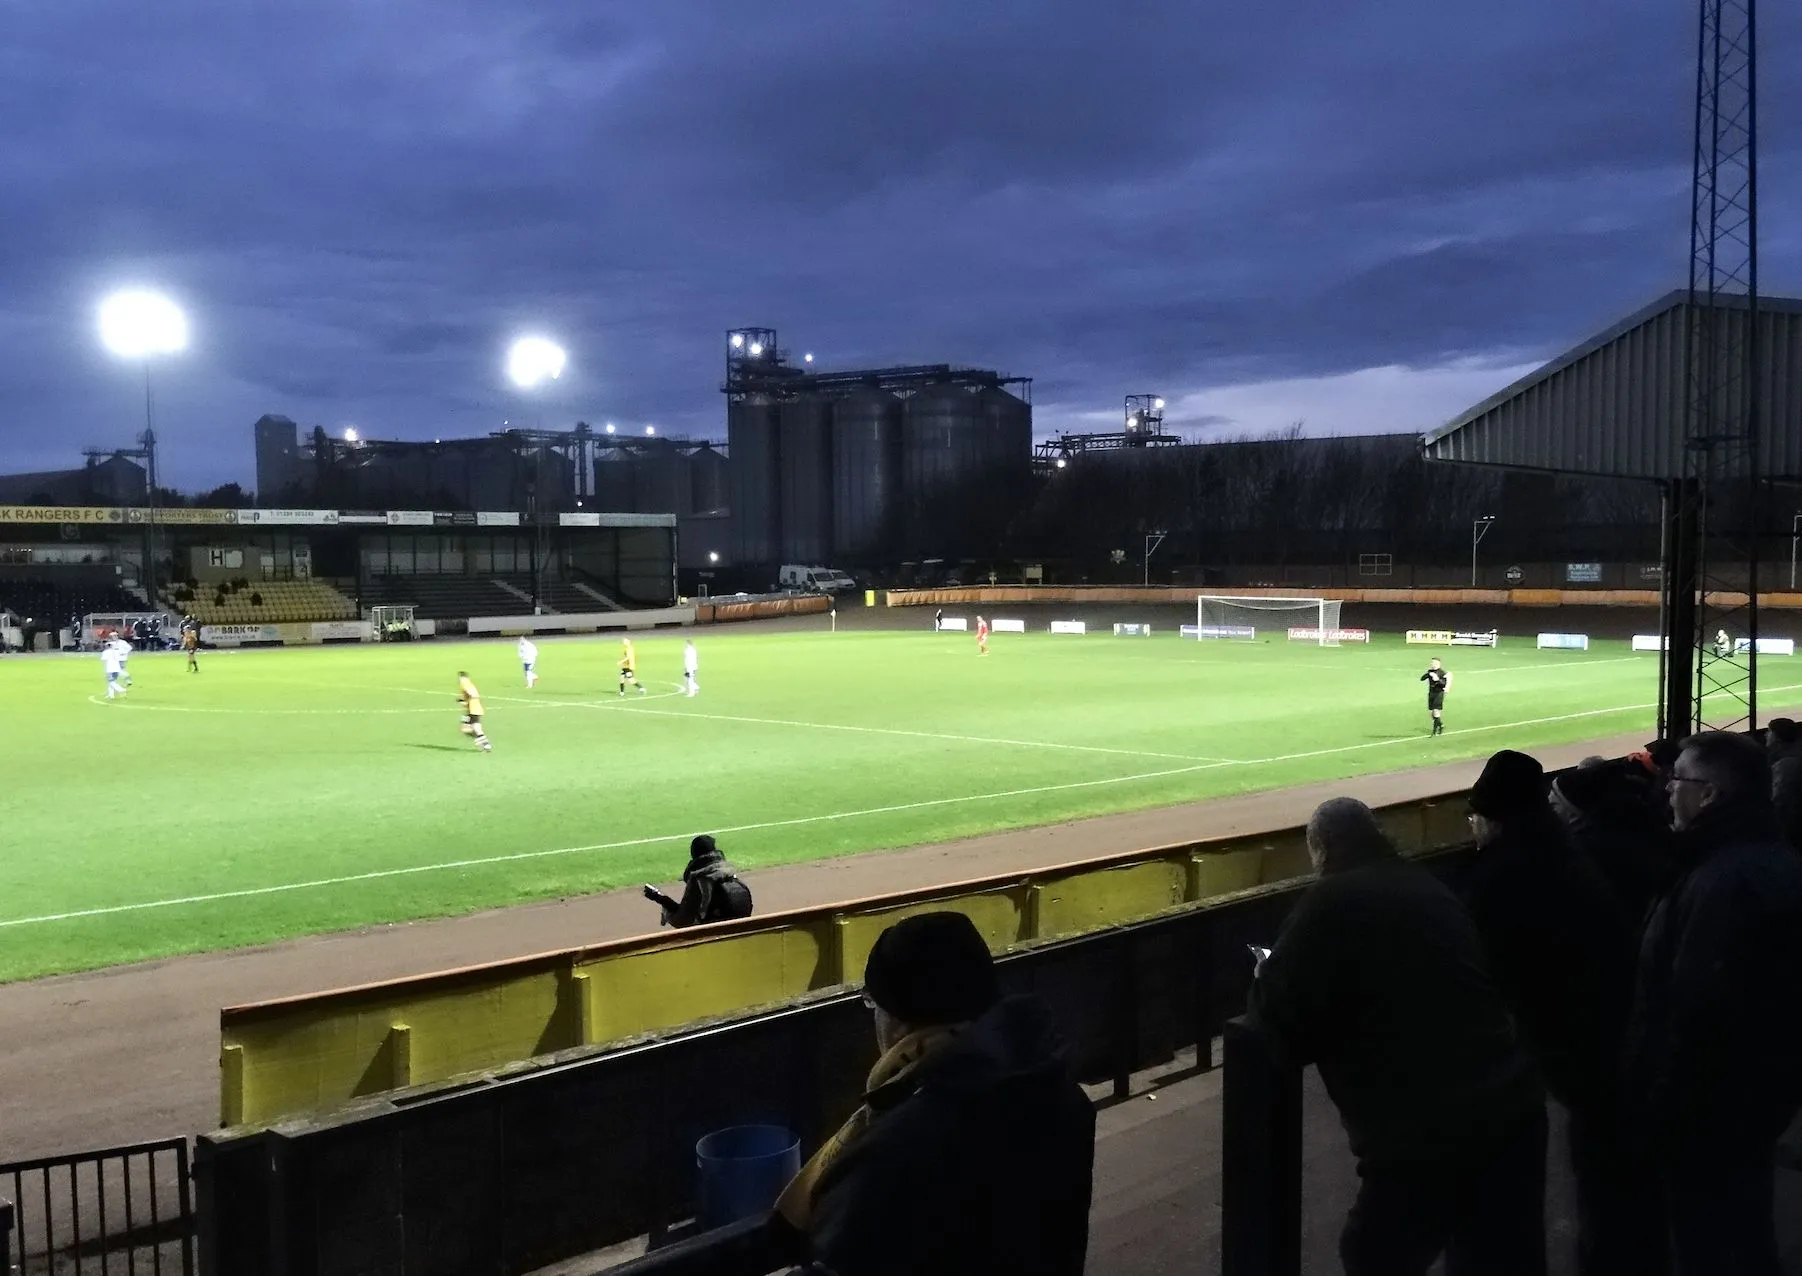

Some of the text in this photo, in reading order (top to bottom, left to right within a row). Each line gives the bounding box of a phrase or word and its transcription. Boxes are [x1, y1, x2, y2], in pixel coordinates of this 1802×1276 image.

[15, 509, 81, 520] RANGERS
[84, 510, 92, 520] F
[95, 510, 104, 521] C
[211, 551, 223, 566] H
[221, 626, 246, 634] BARK
[1290, 629, 1366, 640] Ladbroks Ladbrokes
